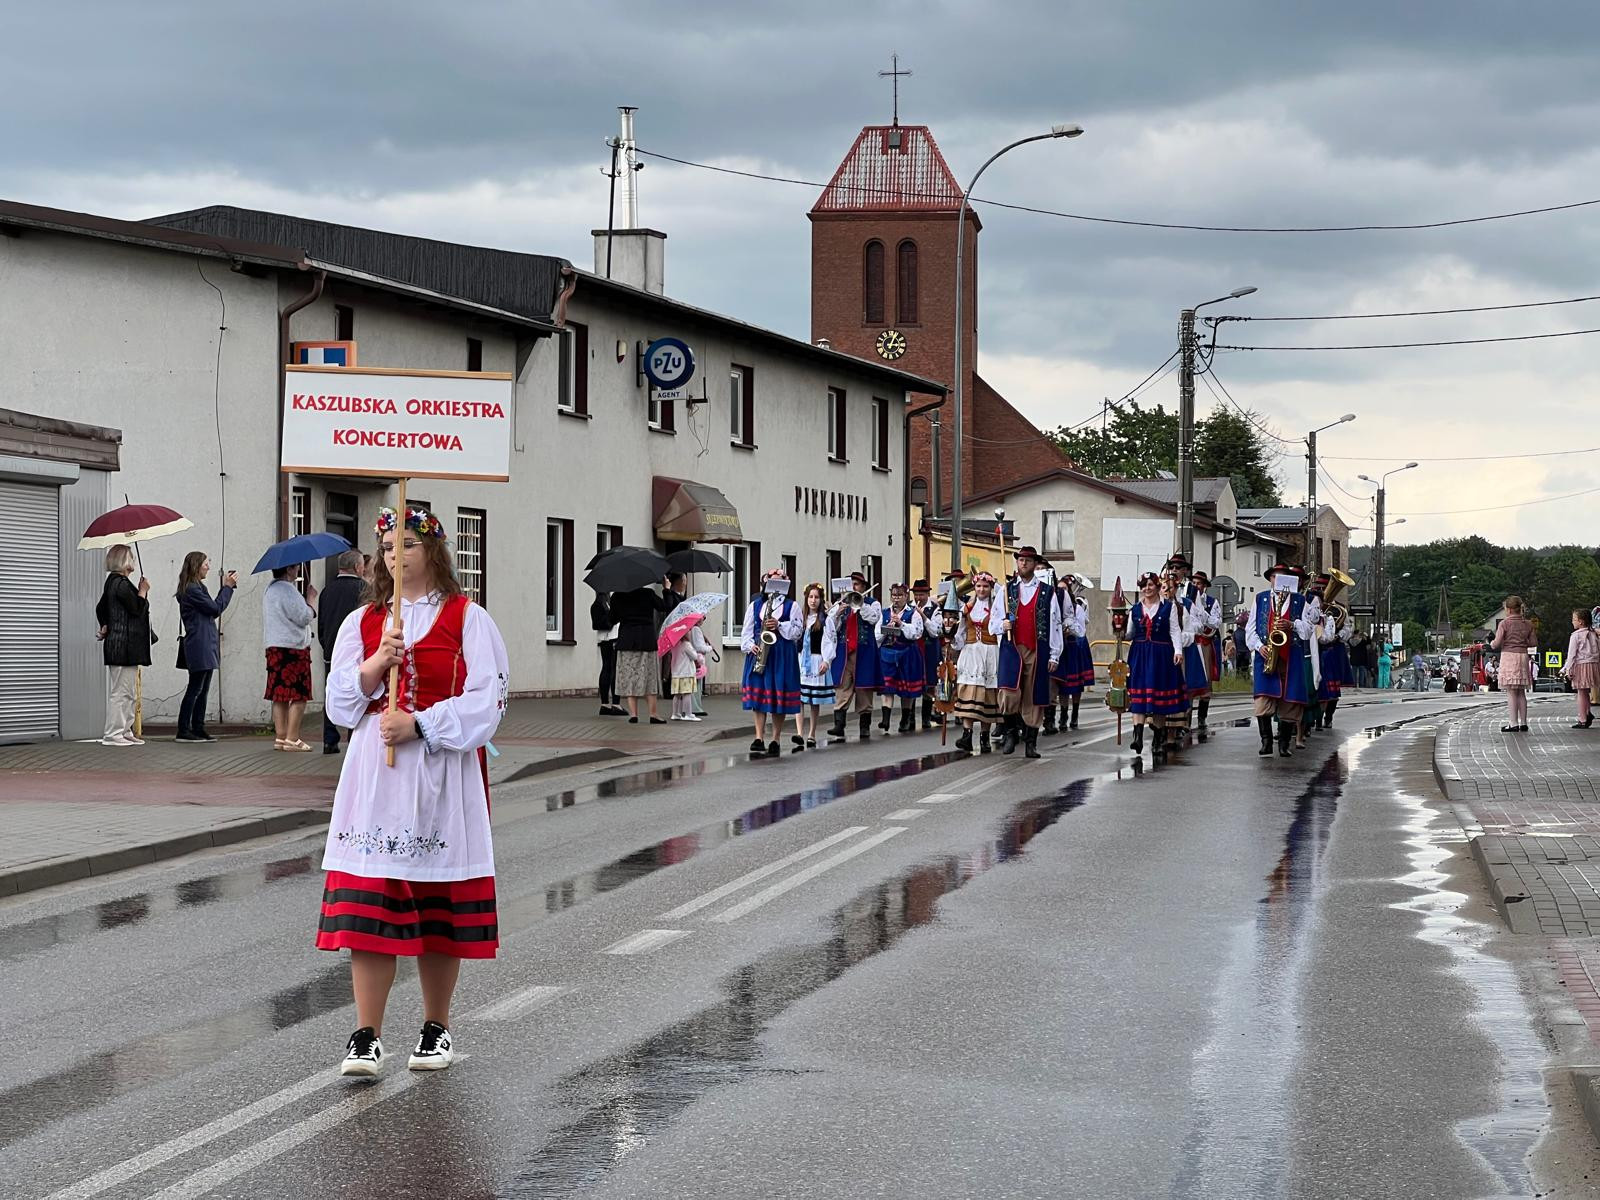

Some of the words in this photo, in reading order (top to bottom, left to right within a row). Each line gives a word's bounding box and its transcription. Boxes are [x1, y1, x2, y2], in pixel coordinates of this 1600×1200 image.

[654, 352, 681, 374] PZU
[657, 391, 680, 399] AGENT
[292, 394, 397, 415] KASZUBSKA
[405, 398, 505, 419] ORKIESTRA
[333, 429, 463, 451] KONCERTOWA
[794, 485, 868, 522] PIEKARNIA
